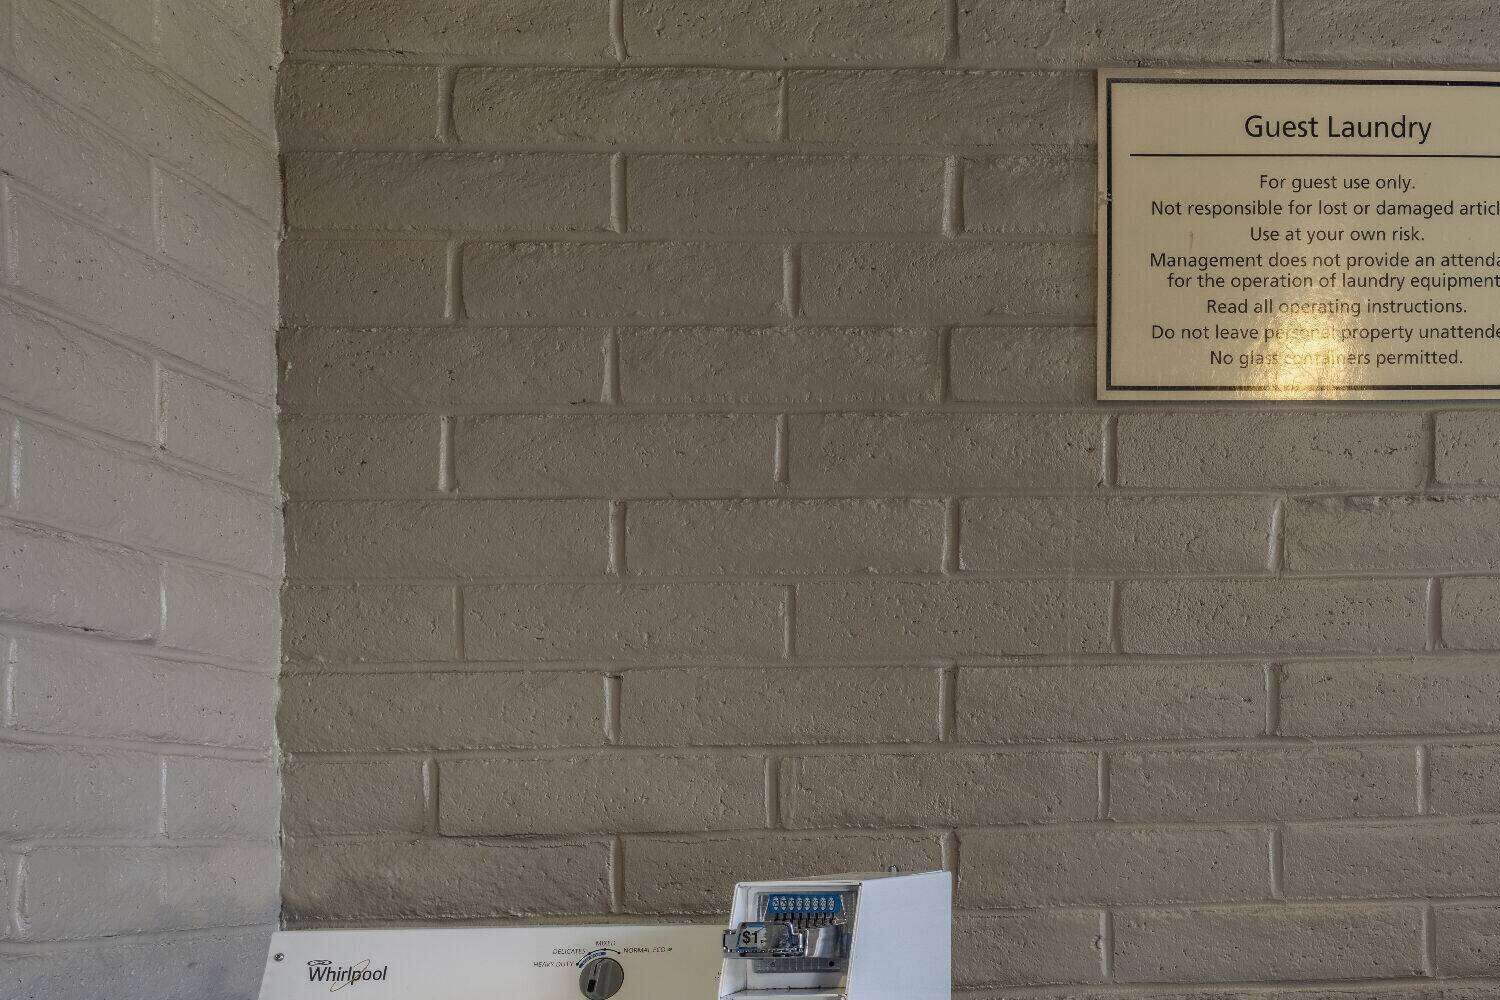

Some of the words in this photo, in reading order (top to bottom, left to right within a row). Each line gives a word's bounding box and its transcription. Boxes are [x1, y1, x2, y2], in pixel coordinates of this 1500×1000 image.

[1244, 114, 1319, 138] Guest
[1328, 114, 1432, 144] Laundry
[1260, 174, 1286, 189] For
[1292, 176, 1337, 193] guest
[1343, 178, 1370, 189] use
[1376, 174, 1416, 193] only.
[1151, 201, 1182, 215] Not
[1188, 200, 1283, 218] responsible
[1288, 200, 1313, 215] for
[1318, 201, 1348, 215] lost
[1353, 204, 1371, 215] or
[1376, 200, 1453, 219] damaged
[1250, 227, 1279, 241] Use
[1285, 229, 1301, 241] at
[1306, 230, 1344, 244] your
[1350, 230, 1386, 241] own
[1392, 227, 1425, 241] risk.
[1150, 252, 1263, 271] Management
[1268, 252, 1307, 267] does
[1312, 253, 1341, 267] not
[1346, 252, 1410, 270] provide
[1415, 255, 1435, 267] an
[1167, 273, 1192, 288] for
[1197, 273, 1225, 288] the
[1230, 273, 1313, 291] operation
[1319, 273, 1337, 288] of
[1342, 273, 1405, 292] laundry
[1207, 299, 1248, 314] Read
[1253, 299, 1273, 314] all
[1278, 299, 1361, 317] operating
[1367, 299, 1467, 313] instructions.
[1151, 325, 1175, 339] Do
[1181, 326, 1210, 339] not
[1215, 325, 1259, 339] leave
[1341, 326, 1414, 342] property
[1210, 350, 1234, 365] No
[1239, 350, 1279, 368] glass
[1376, 350, 1463, 368] permitted.
[308, 966, 388, 985] Whirlpool
